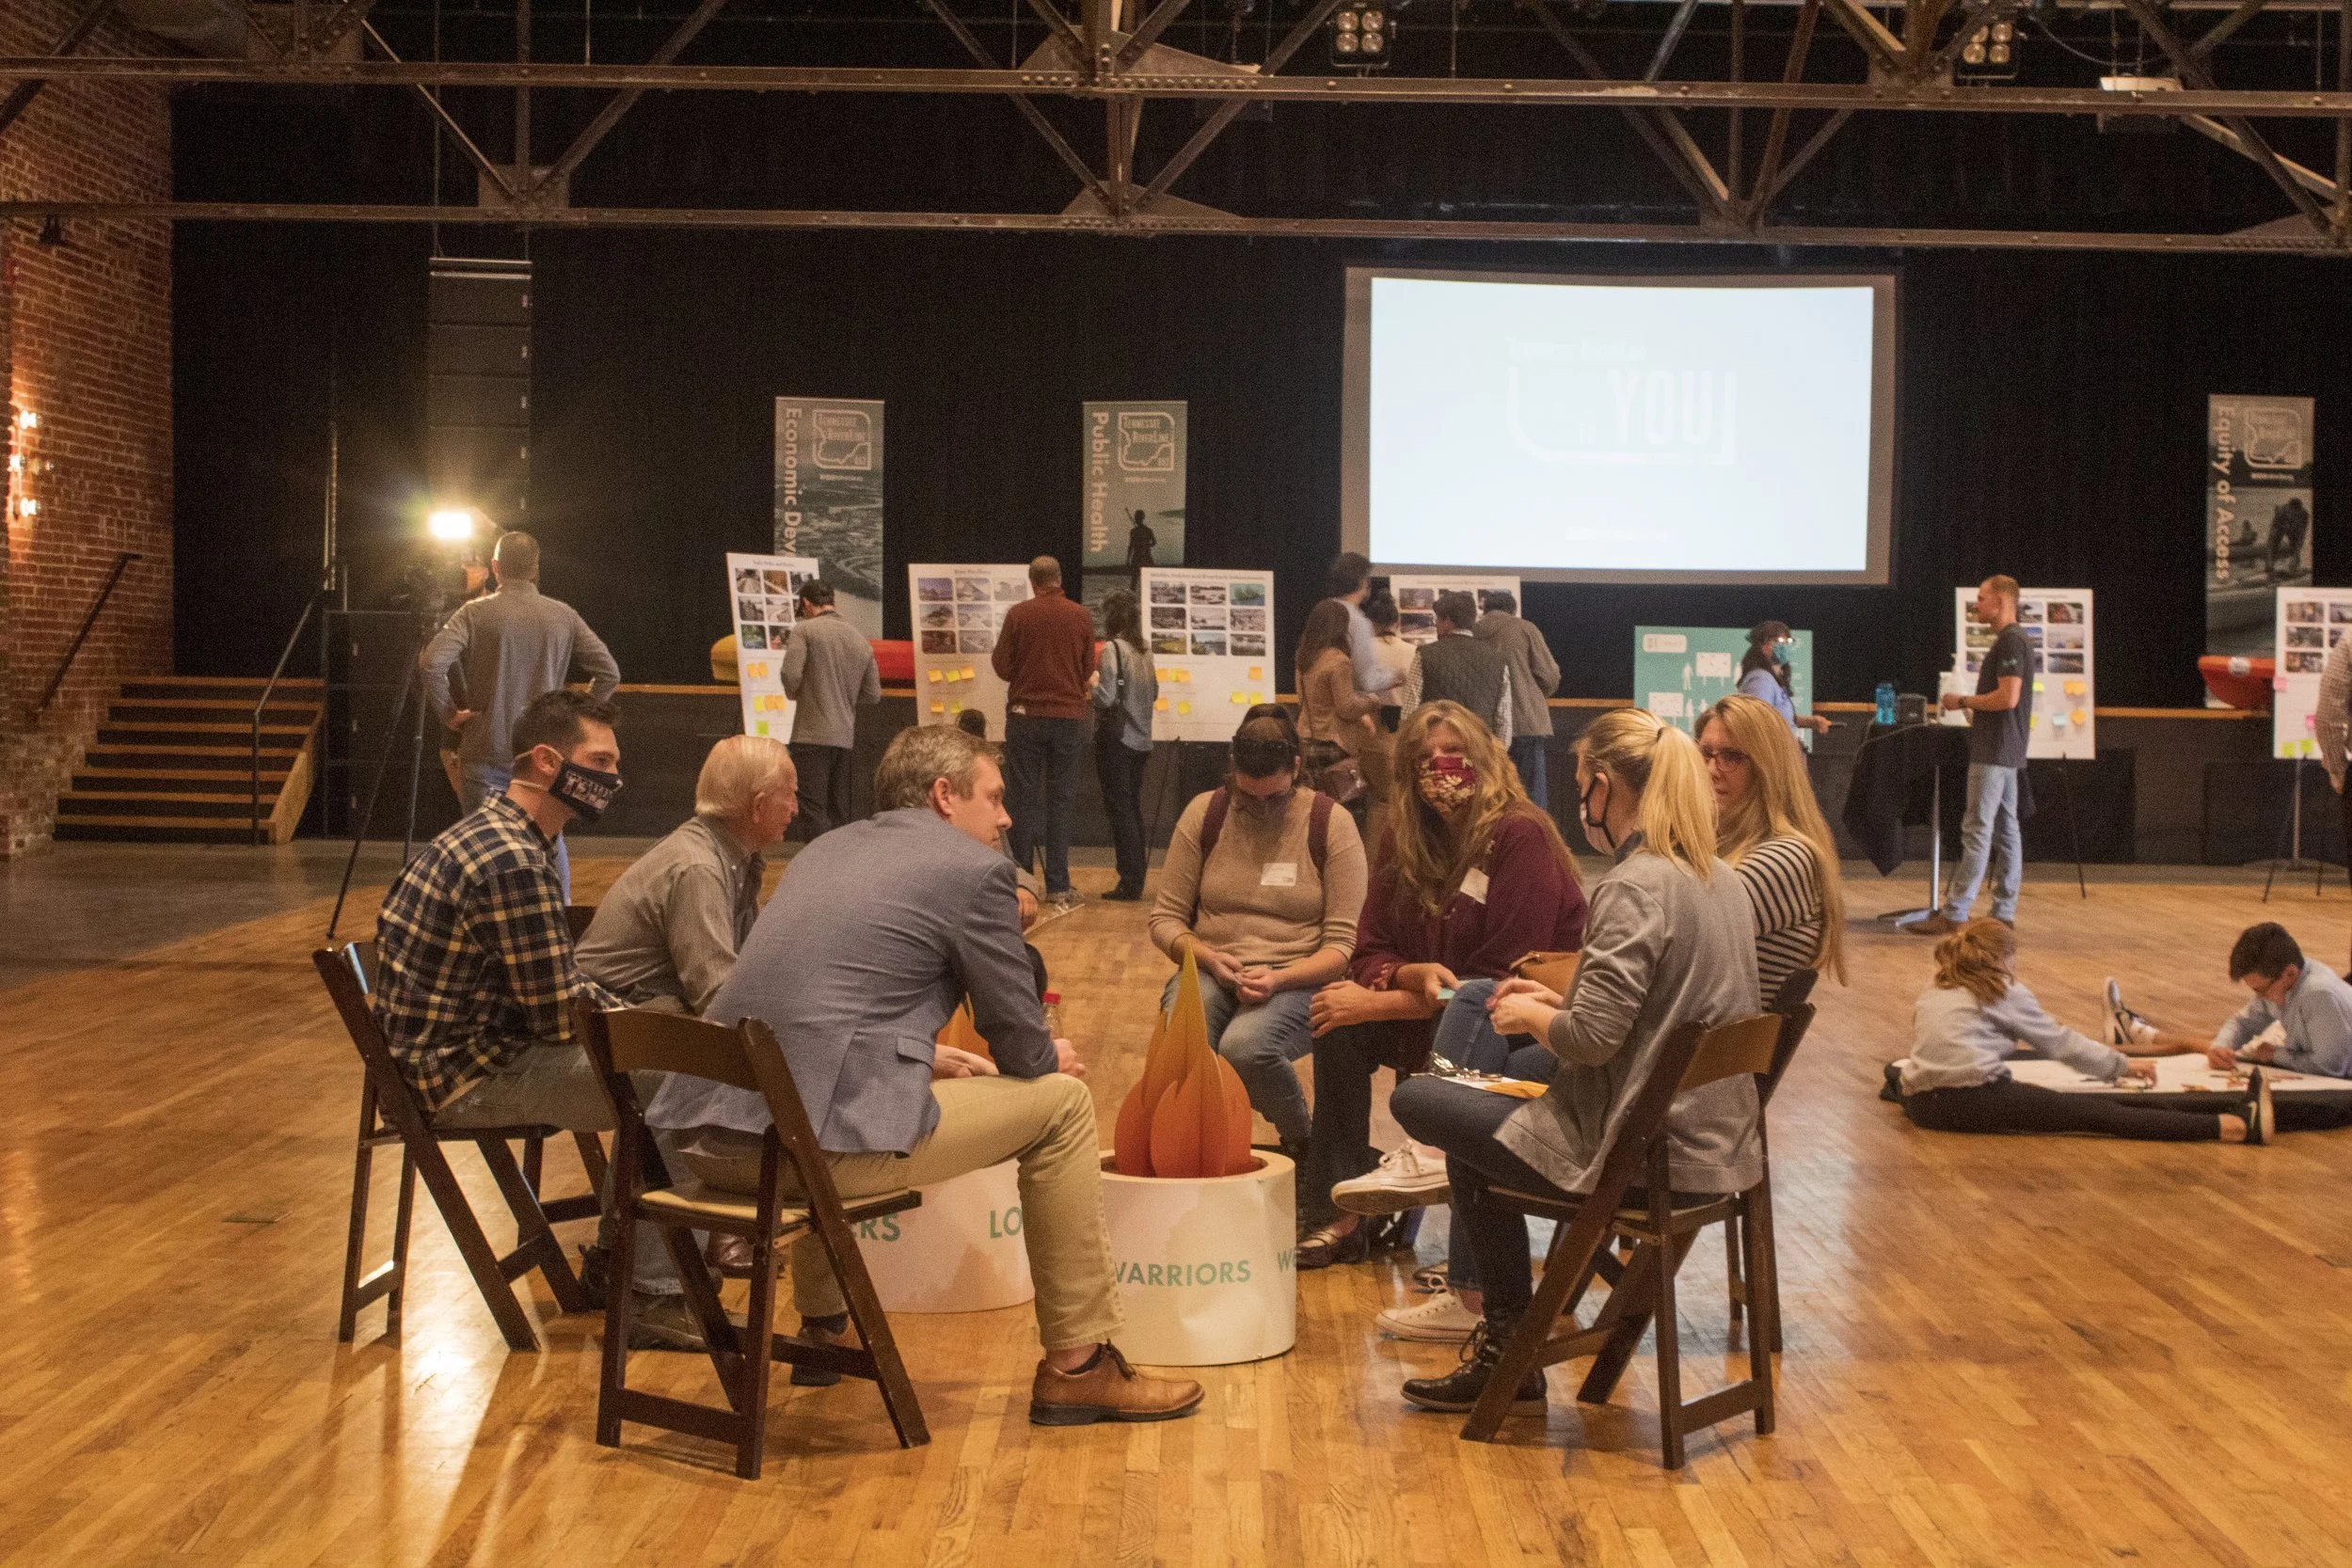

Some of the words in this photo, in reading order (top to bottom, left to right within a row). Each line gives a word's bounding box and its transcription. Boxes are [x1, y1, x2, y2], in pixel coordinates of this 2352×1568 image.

[784, 408, 803, 506] Economic
[1091, 411, 1110, 475] Public
[2212, 405, 2236, 475] Equity
[1090, 483, 1109, 552] Health
[2217, 479, 2237, 503] of
[2216, 508, 2234, 579] Access
